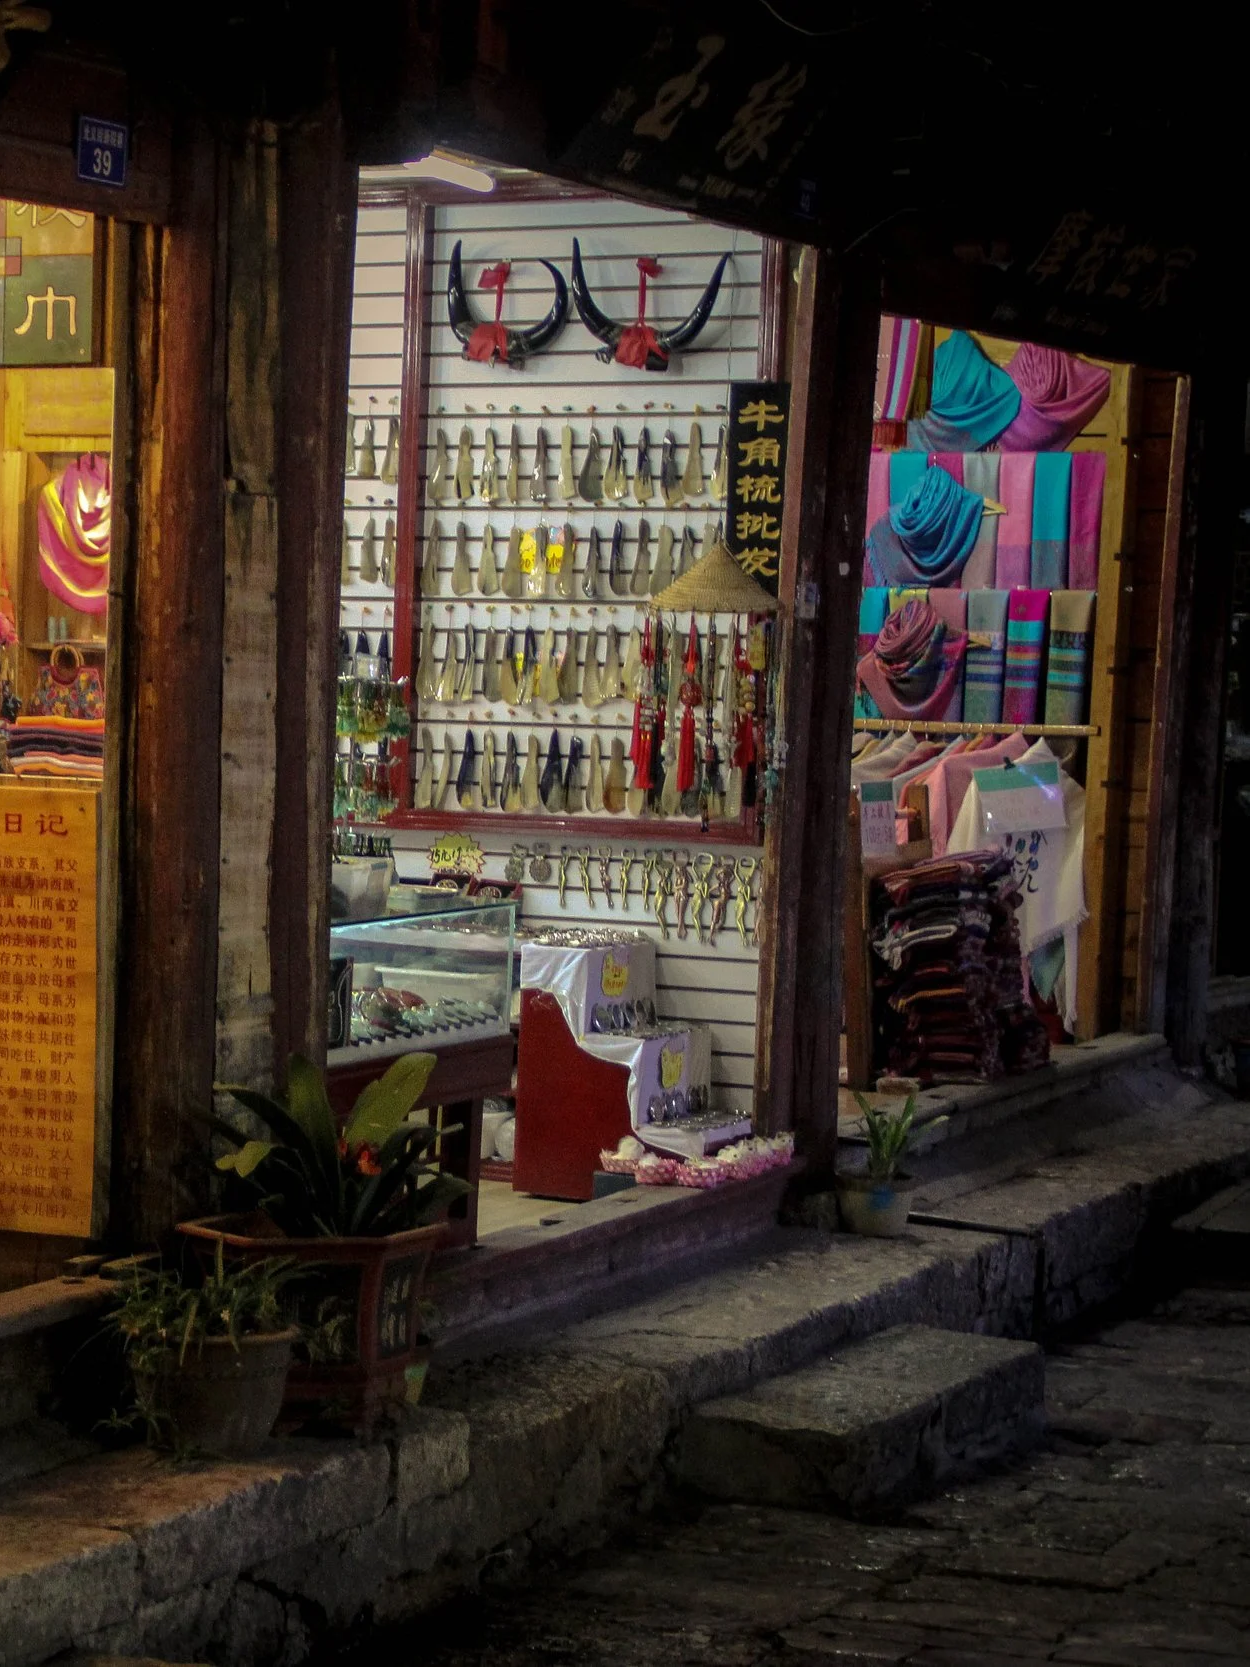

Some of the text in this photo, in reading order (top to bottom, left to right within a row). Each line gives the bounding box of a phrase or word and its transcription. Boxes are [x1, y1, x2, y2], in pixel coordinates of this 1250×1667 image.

[93, 147, 112, 177] 39
[735, 399, 785, 577] 牛角梳批发
